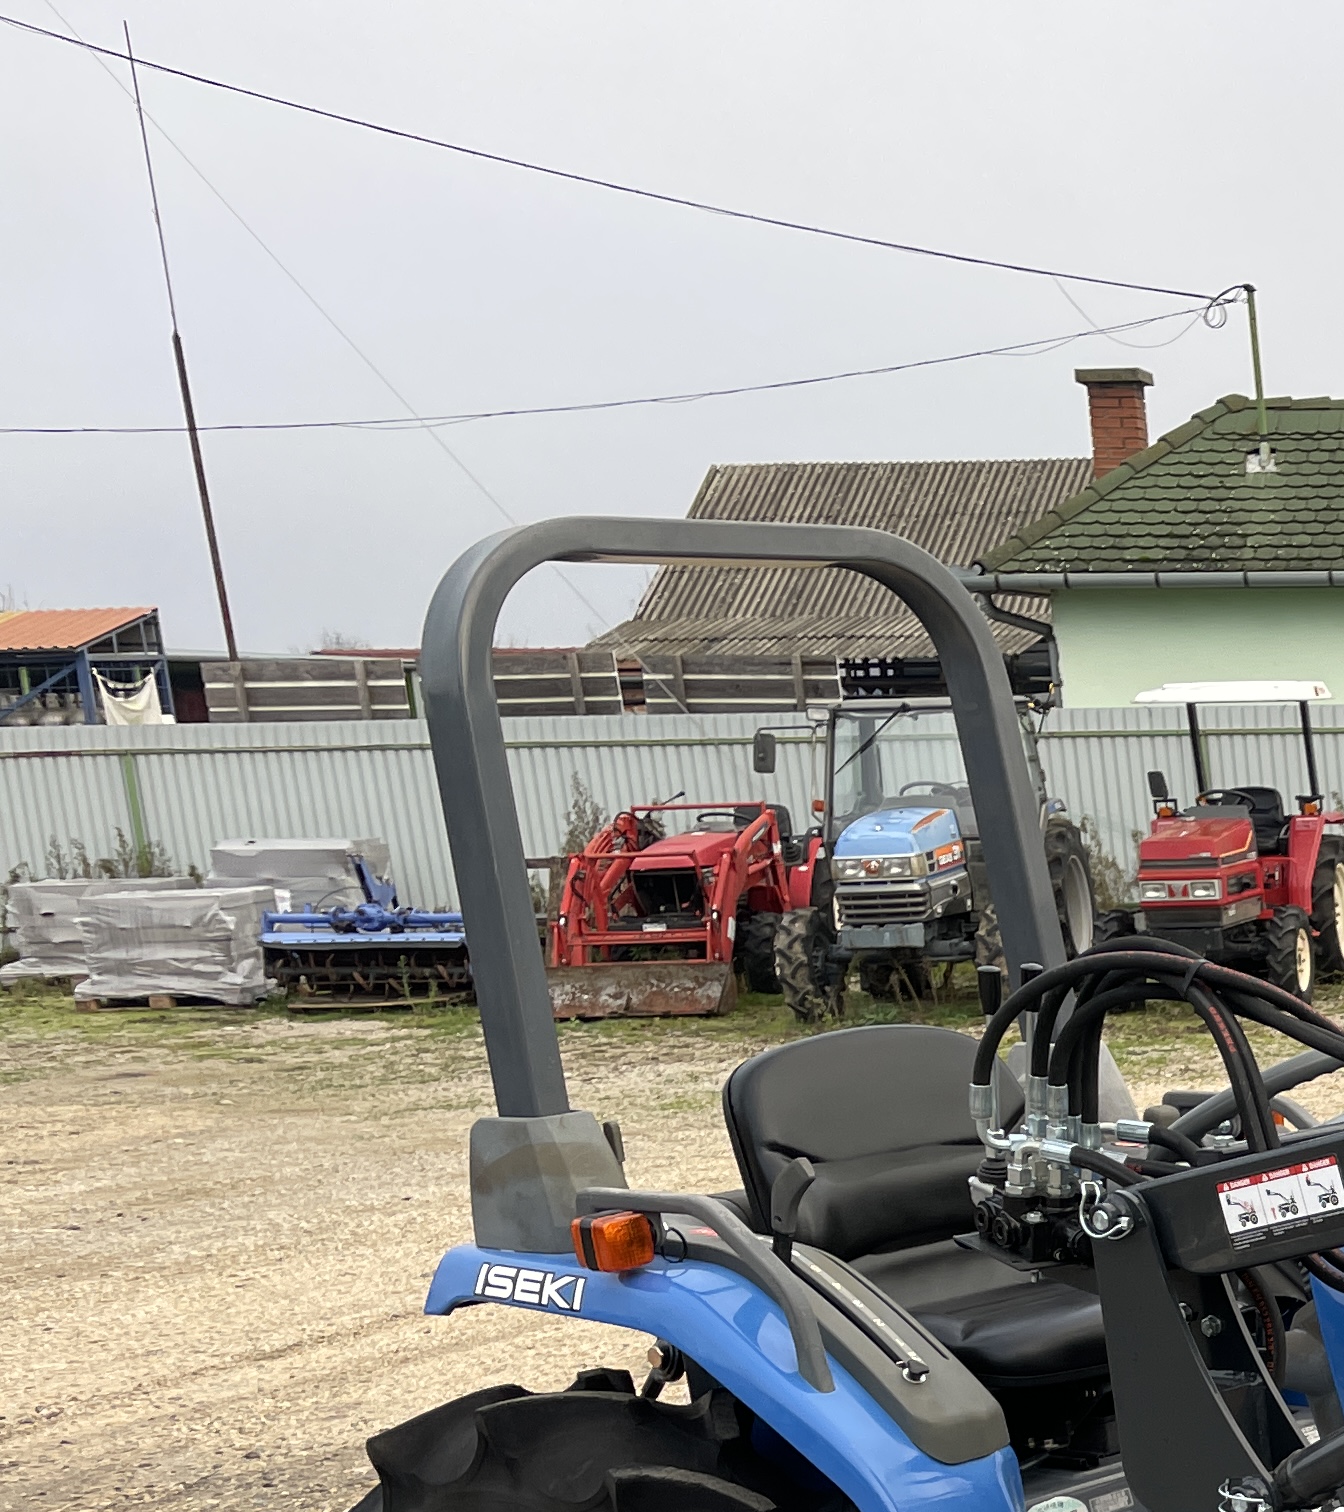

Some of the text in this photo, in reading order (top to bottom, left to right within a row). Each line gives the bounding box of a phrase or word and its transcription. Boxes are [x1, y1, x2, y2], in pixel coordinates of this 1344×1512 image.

[1309, 1158, 1331, 1170] DANGER
[1268, 1168, 1290, 1180] DANGER
[1230, 1178, 1251, 1189] DANGER
[475, 1262, 587, 1312] ISEKI
